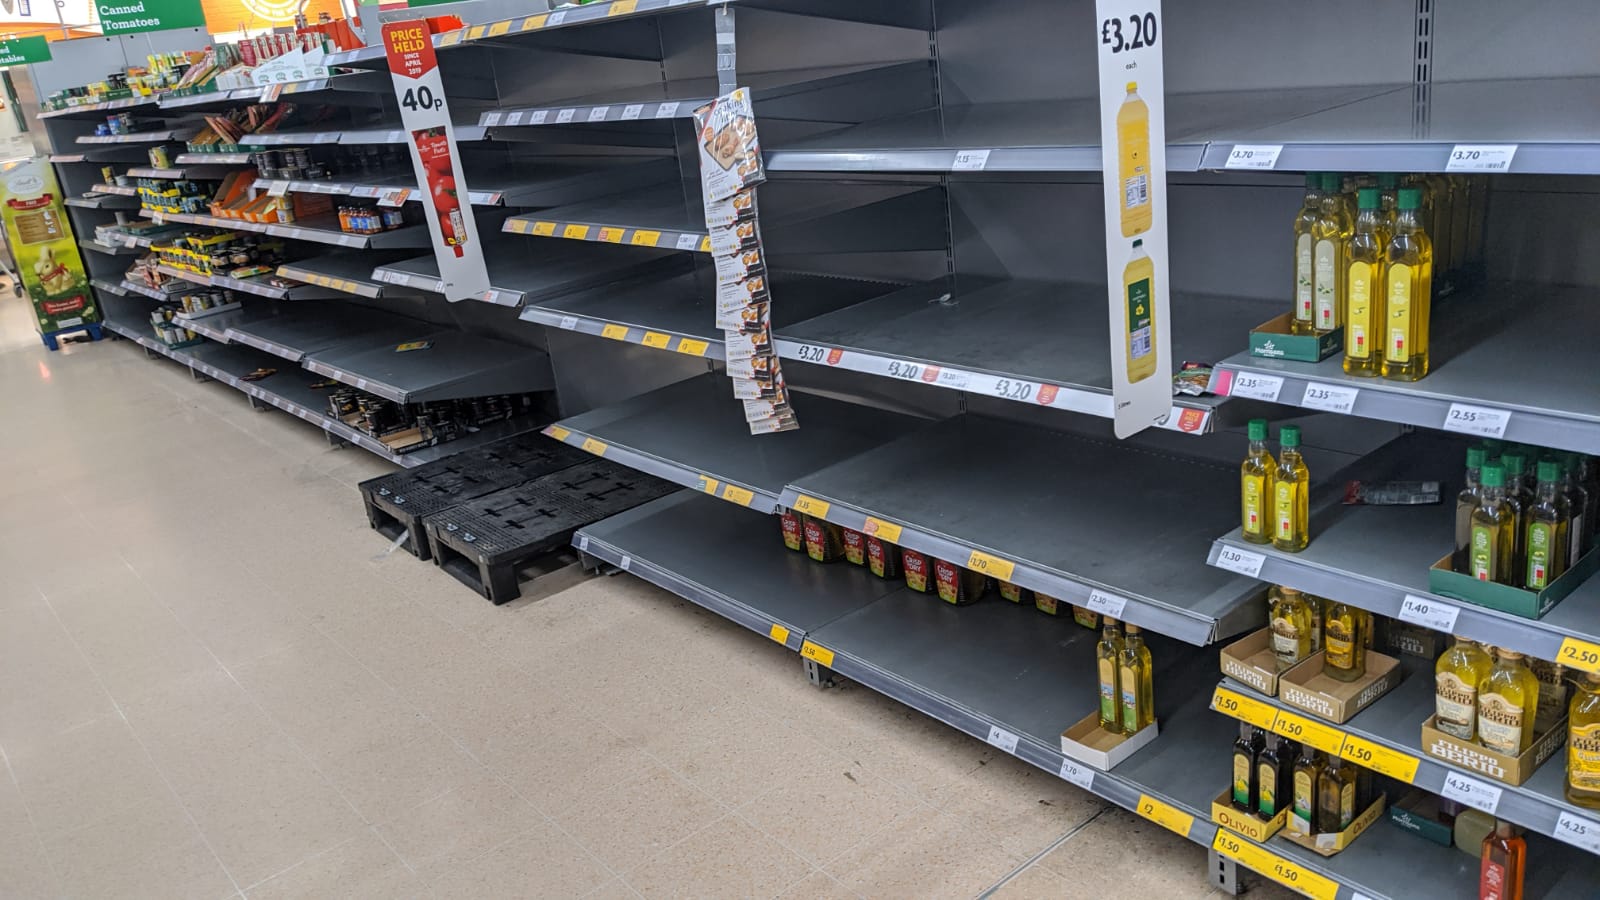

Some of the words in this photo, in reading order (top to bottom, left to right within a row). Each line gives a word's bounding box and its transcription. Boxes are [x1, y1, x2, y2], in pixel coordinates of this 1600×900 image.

[100, 1, 145, 16] Canned
[103, 17, 160, 31] Tomatoes
[390, 28, 424, 42] PRICE
[1101, 12, 1157, 53] £3.20
[393, 40, 425, 53] HELD
[404, 52, 419, 60] SINCE
[405, 59, 422, 67] APRIL
[1125, 62, 1138, 70] each
[402, 85, 443, 112] 40p
[1452, 150, 1481, 160] £3.70
[798, 344, 825, 362] £3.20
[887, 360, 919, 379] £3.20
[994, 378, 1032, 400] £3.20
[1237, 377, 1257, 388] £2.35
[1307, 388, 1329, 399] £2.35
[1450, 409, 1477, 422] £2.55
[806, 527, 819, 537] CRISP
[868, 540, 881, 552] CRISP
[905, 555, 922, 566] CRISP
[969, 556, 987, 569] £1.70
[1221, 550, 1241, 562] £1.30
[909, 563, 921, 572] DRY
[937, 565, 954, 577] CRISP
[942, 574, 953, 583] DRY
[1404, 601, 1429, 614] £1.40
[1563, 646, 1598, 664] £2.50
[1225, 663, 1266, 691] BERIO
[1228, 660, 1263, 681] FILIPPO
[1215, 694, 1238, 712] £1.50
[1284, 692, 1334, 717] BERIO
[1288, 688, 1329, 708] FILIPPO
[1277, 718, 1303, 736] £1.50
[1344, 742, 1372, 762] £1.50
[1438, 738, 1499, 766] FILIPPO
[1062, 763, 1077, 775] £1.70
[1430, 744, 1505, 779] BERIO
[1447, 778, 1472, 793] £4.25
[1218, 812, 1258, 838] OLIVIO
[1353, 810, 1377, 834] OLIVIO
[1559, 818, 1587, 835] £4.25
[1219, 835, 1240, 854] £1.50
[1274, 863, 1298, 882] £1.50
